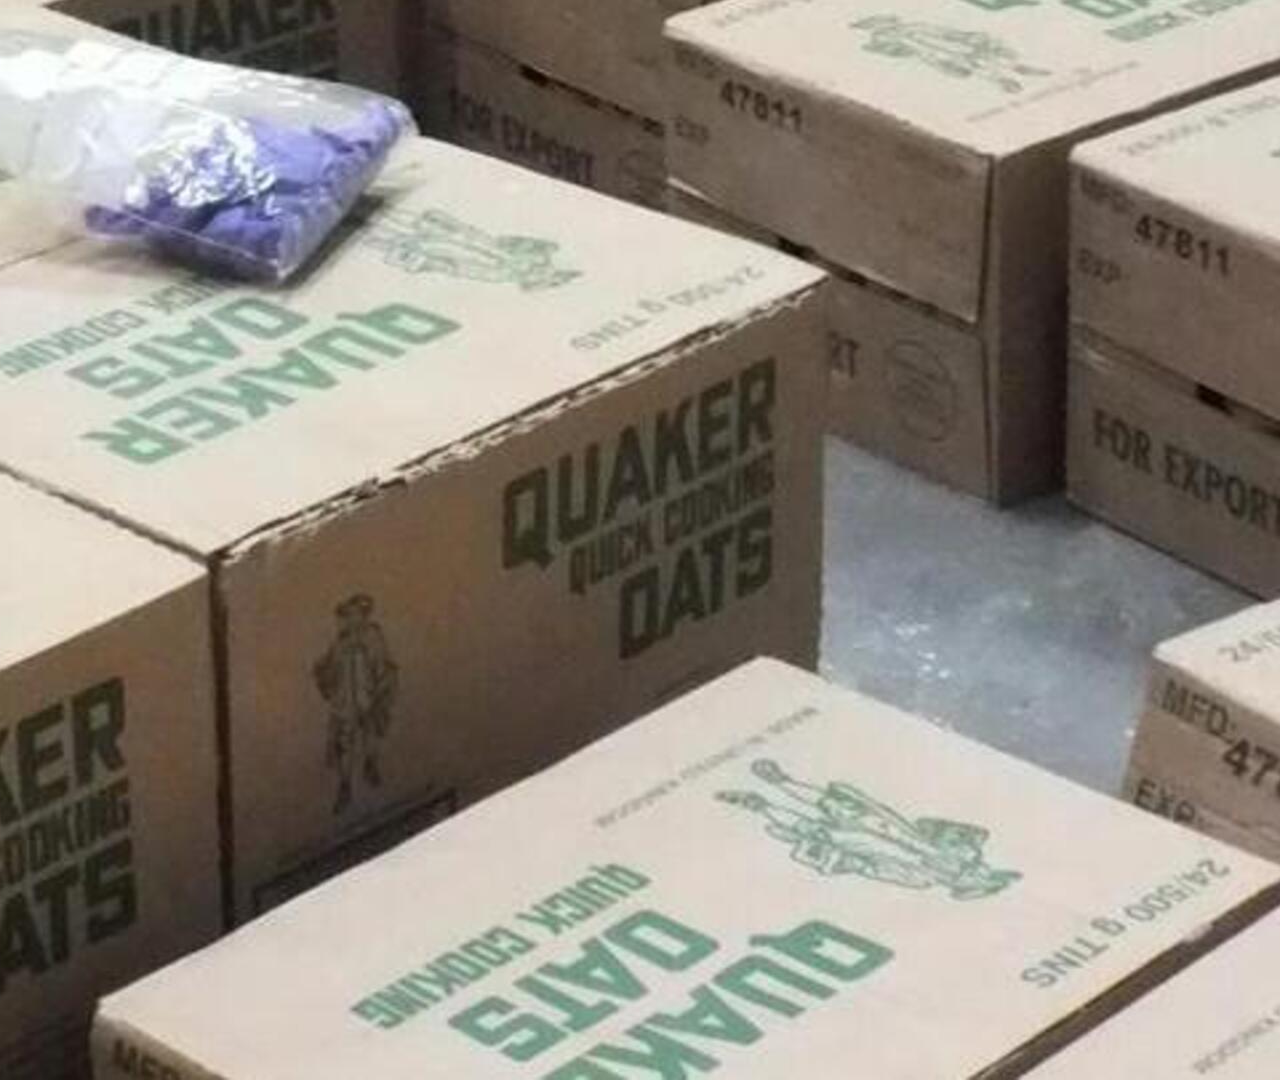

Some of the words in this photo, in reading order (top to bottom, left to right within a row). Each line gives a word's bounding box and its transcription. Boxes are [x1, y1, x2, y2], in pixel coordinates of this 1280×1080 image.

[1133, 211, 1231, 277] 47811
[65, 296, 310, 398] OATS
[81, 301, 463, 466] QUAKER
[501, 355, 777, 572] QUAKER
[1091, 408, 1152, 474] FOR
[568, 517, 654, 597] QUICK
[663, 449, 777, 547] COOKING
[620, 505, 774, 661] OATS
[515, 862, 654, 939] QUICK
[1100, 914, 1126, 942] g
[1126, 856, 1232, 925] 24/500
[349, 923, 540, 1031] COOKING
[446, 906, 722, 1064] OATS
[1020, 936, 1110, 992] TINS
